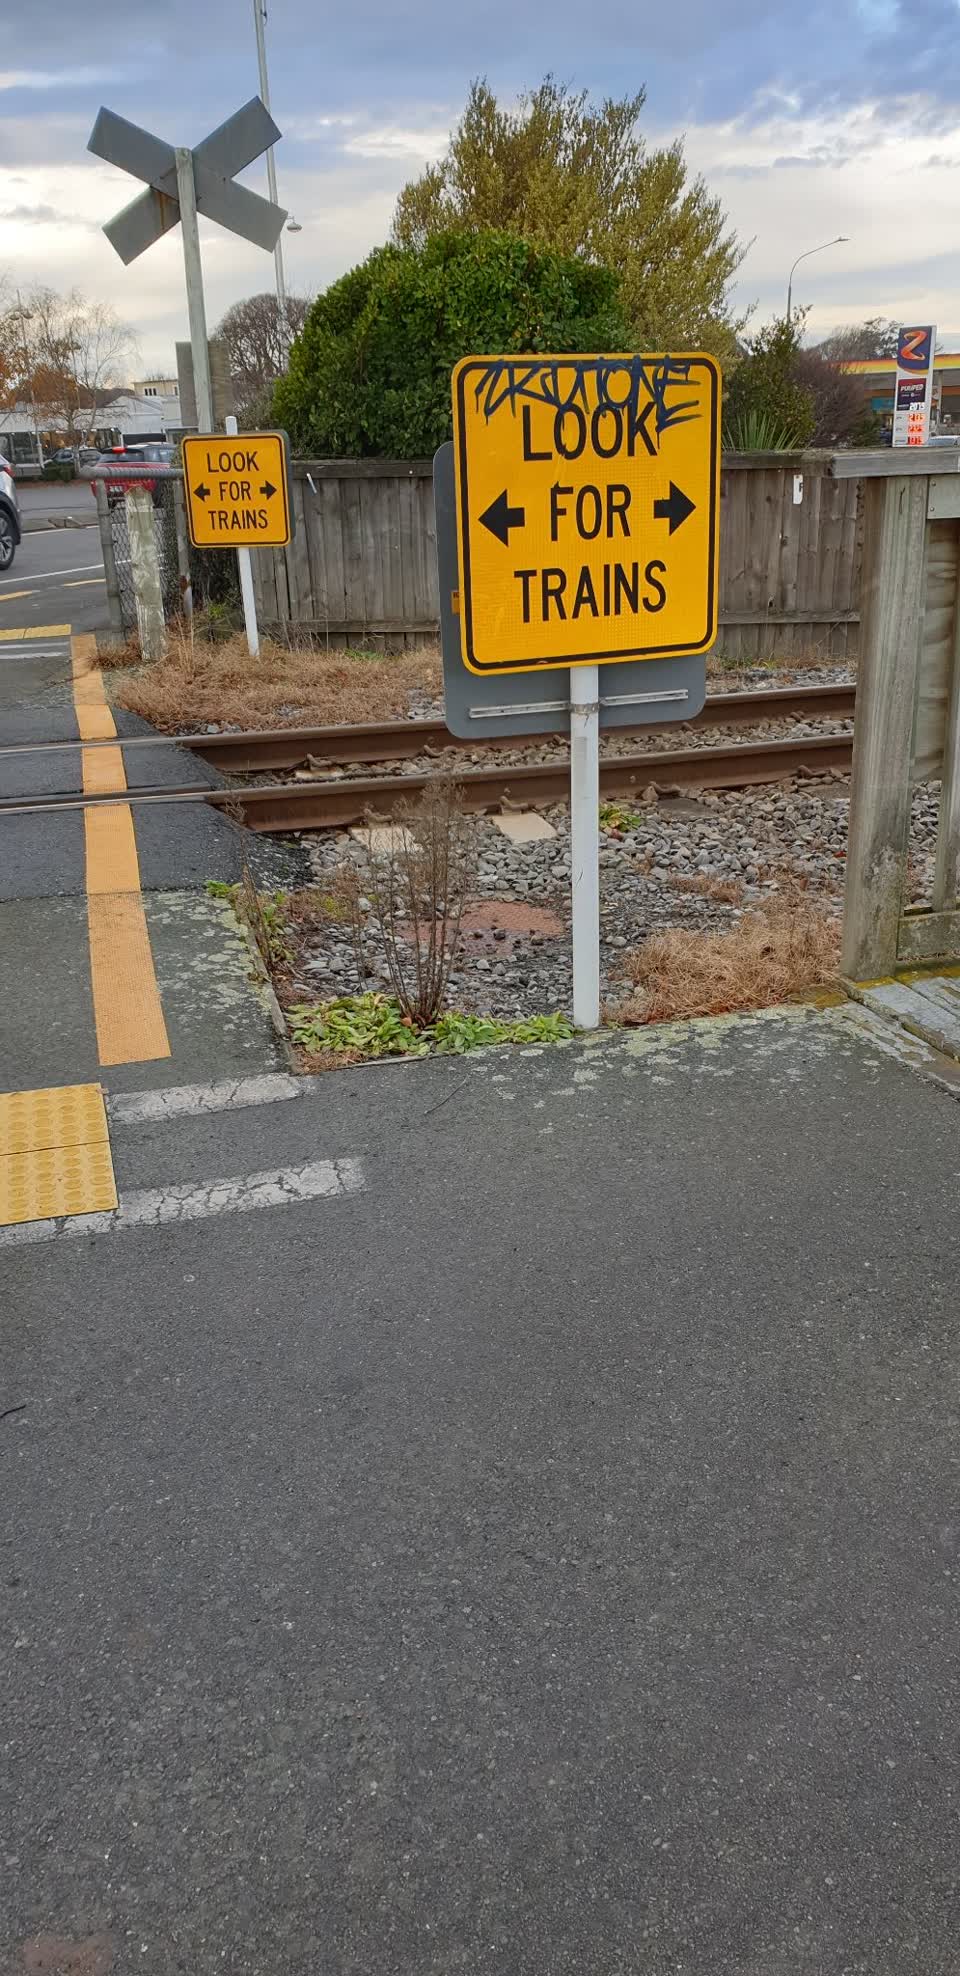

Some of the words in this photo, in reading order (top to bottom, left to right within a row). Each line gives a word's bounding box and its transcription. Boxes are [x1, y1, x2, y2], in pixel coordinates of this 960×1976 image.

[522, 402, 658, 461] LOOK
[207, 451, 259, 473] LOOK
[219, 480, 252, 501] FOR
[208, 509, 268, 530] TRAINS
[550, 484, 632, 541] FOR
[513, 559, 667, 623] TRAINS
